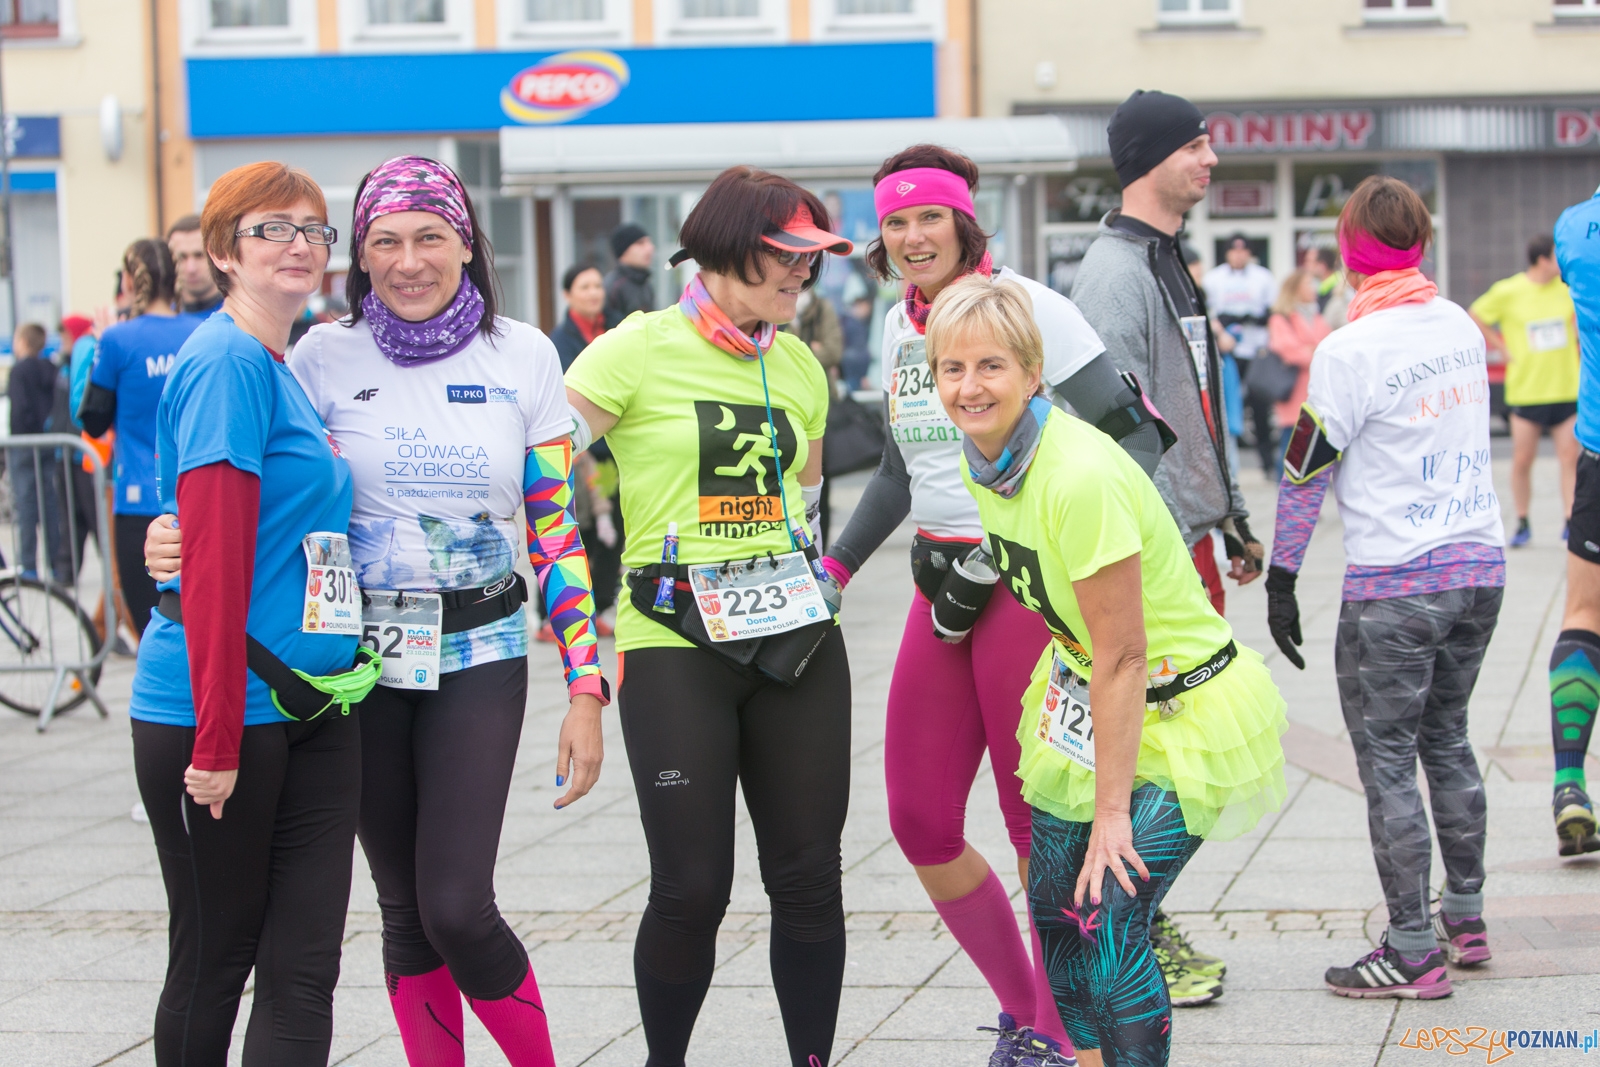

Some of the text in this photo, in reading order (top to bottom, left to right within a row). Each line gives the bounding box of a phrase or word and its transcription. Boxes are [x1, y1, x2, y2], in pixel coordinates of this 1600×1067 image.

[519, 72, 608, 101] PEPCO
[1554, 108, 1600, 144] D
[898, 366, 936, 398] 234
[1385, 354, 1452, 396] SUKNIE
[463, 390, 483, 399] PKO
[902, 399, 928, 409] Honorata
[384, 426, 427, 441] SIŁA
[397, 444, 489, 460] ODWAGA
[384, 461, 490, 479] SZYBKOŚĆ
[1422, 450, 1447, 482] W
[386, 487, 489, 499] 9 października 2016
[720, 497, 773, 521] night
[722, 585, 788, 617] 223
[738, 618, 800, 636] POLINOVA POLSKA
[745, 615, 778, 627] Dorota
[1052, 738, 1077, 759] POLINOVA
[1063, 731, 1084, 751] Elwira
